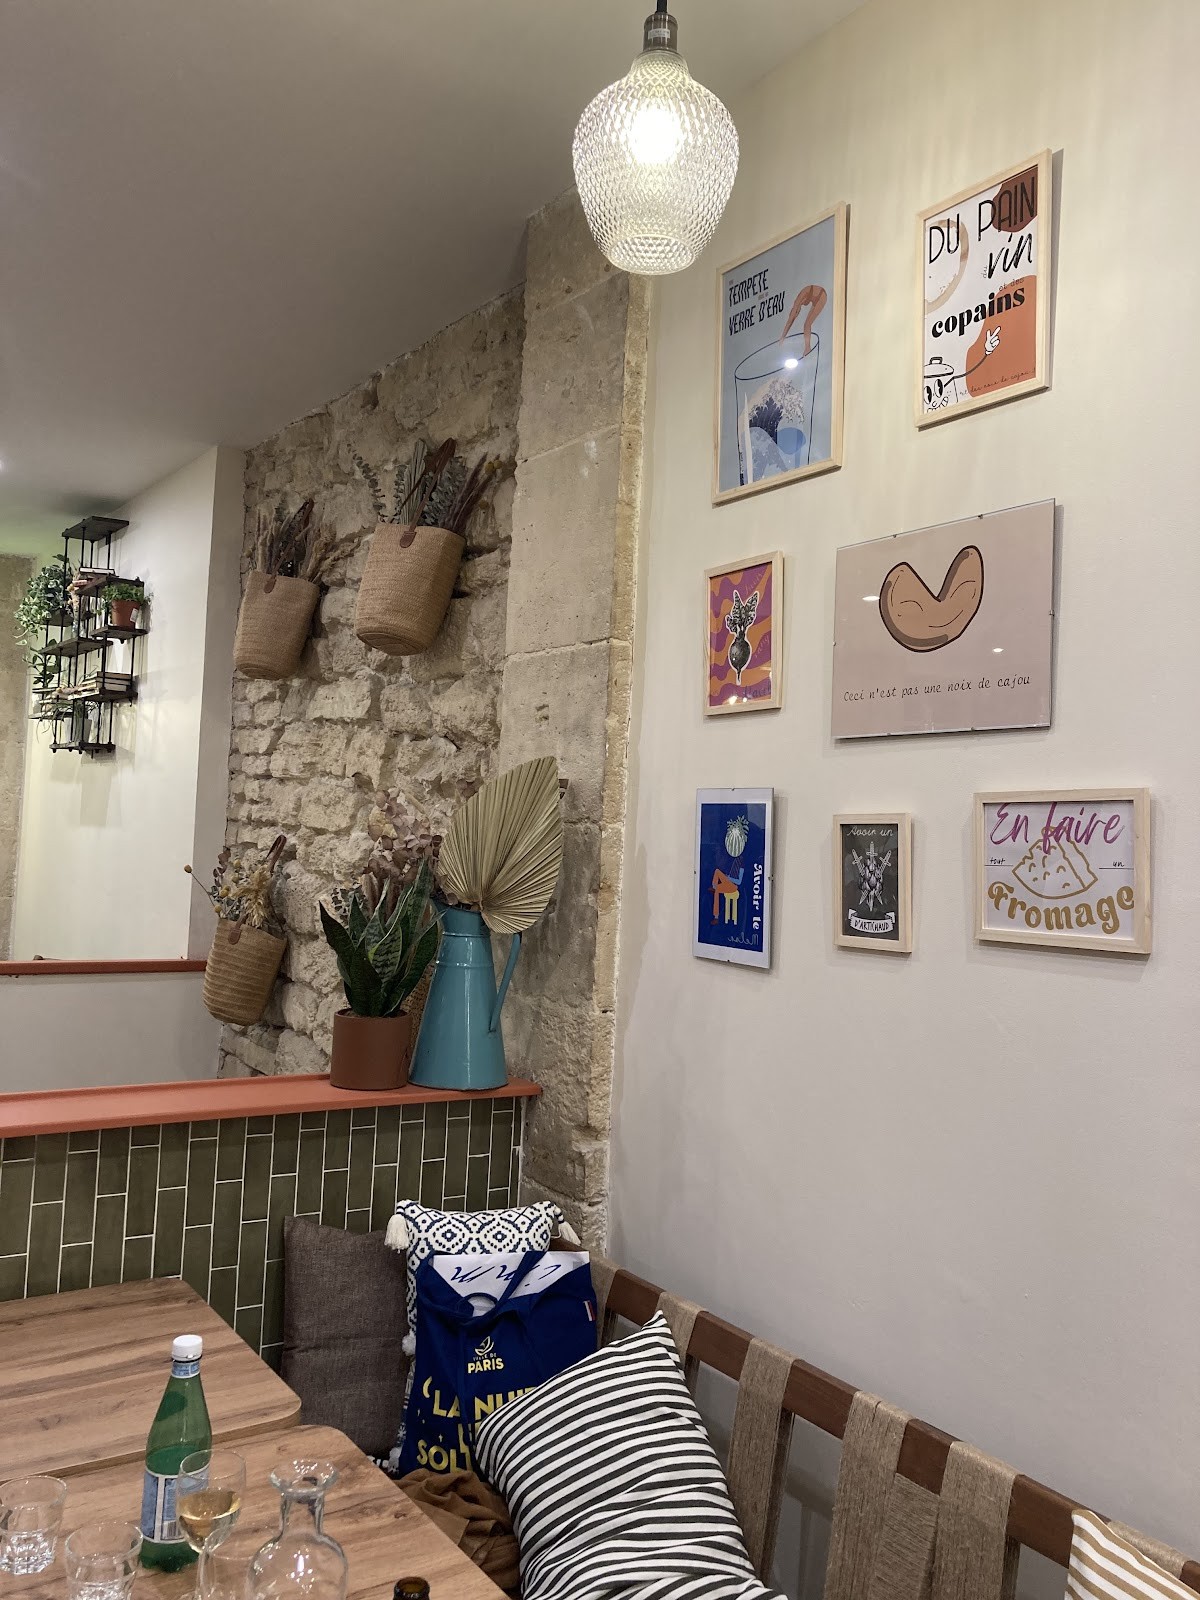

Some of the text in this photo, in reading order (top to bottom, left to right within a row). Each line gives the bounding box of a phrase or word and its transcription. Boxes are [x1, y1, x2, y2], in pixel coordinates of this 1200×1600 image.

[928, 176, 1035, 264] DU PAIN
[987, 233, 1032, 279] vin
[729, 268, 769, 307] TEMPETE
[729, 290, 786, 336] VERRE D'EAU
[931, 287, 1026, 338] copains
[843, 673, 1031, 702] Ceci n'est pas une noix de cajou
[989, 801, 1126, 855] En faire
[1112, 860, 1126, 868] un
[753, 863, 763, 930] Avoir le
[987, 881, 1135, 935] Fromage
[467, 1357, 505, 1374] PARIS
